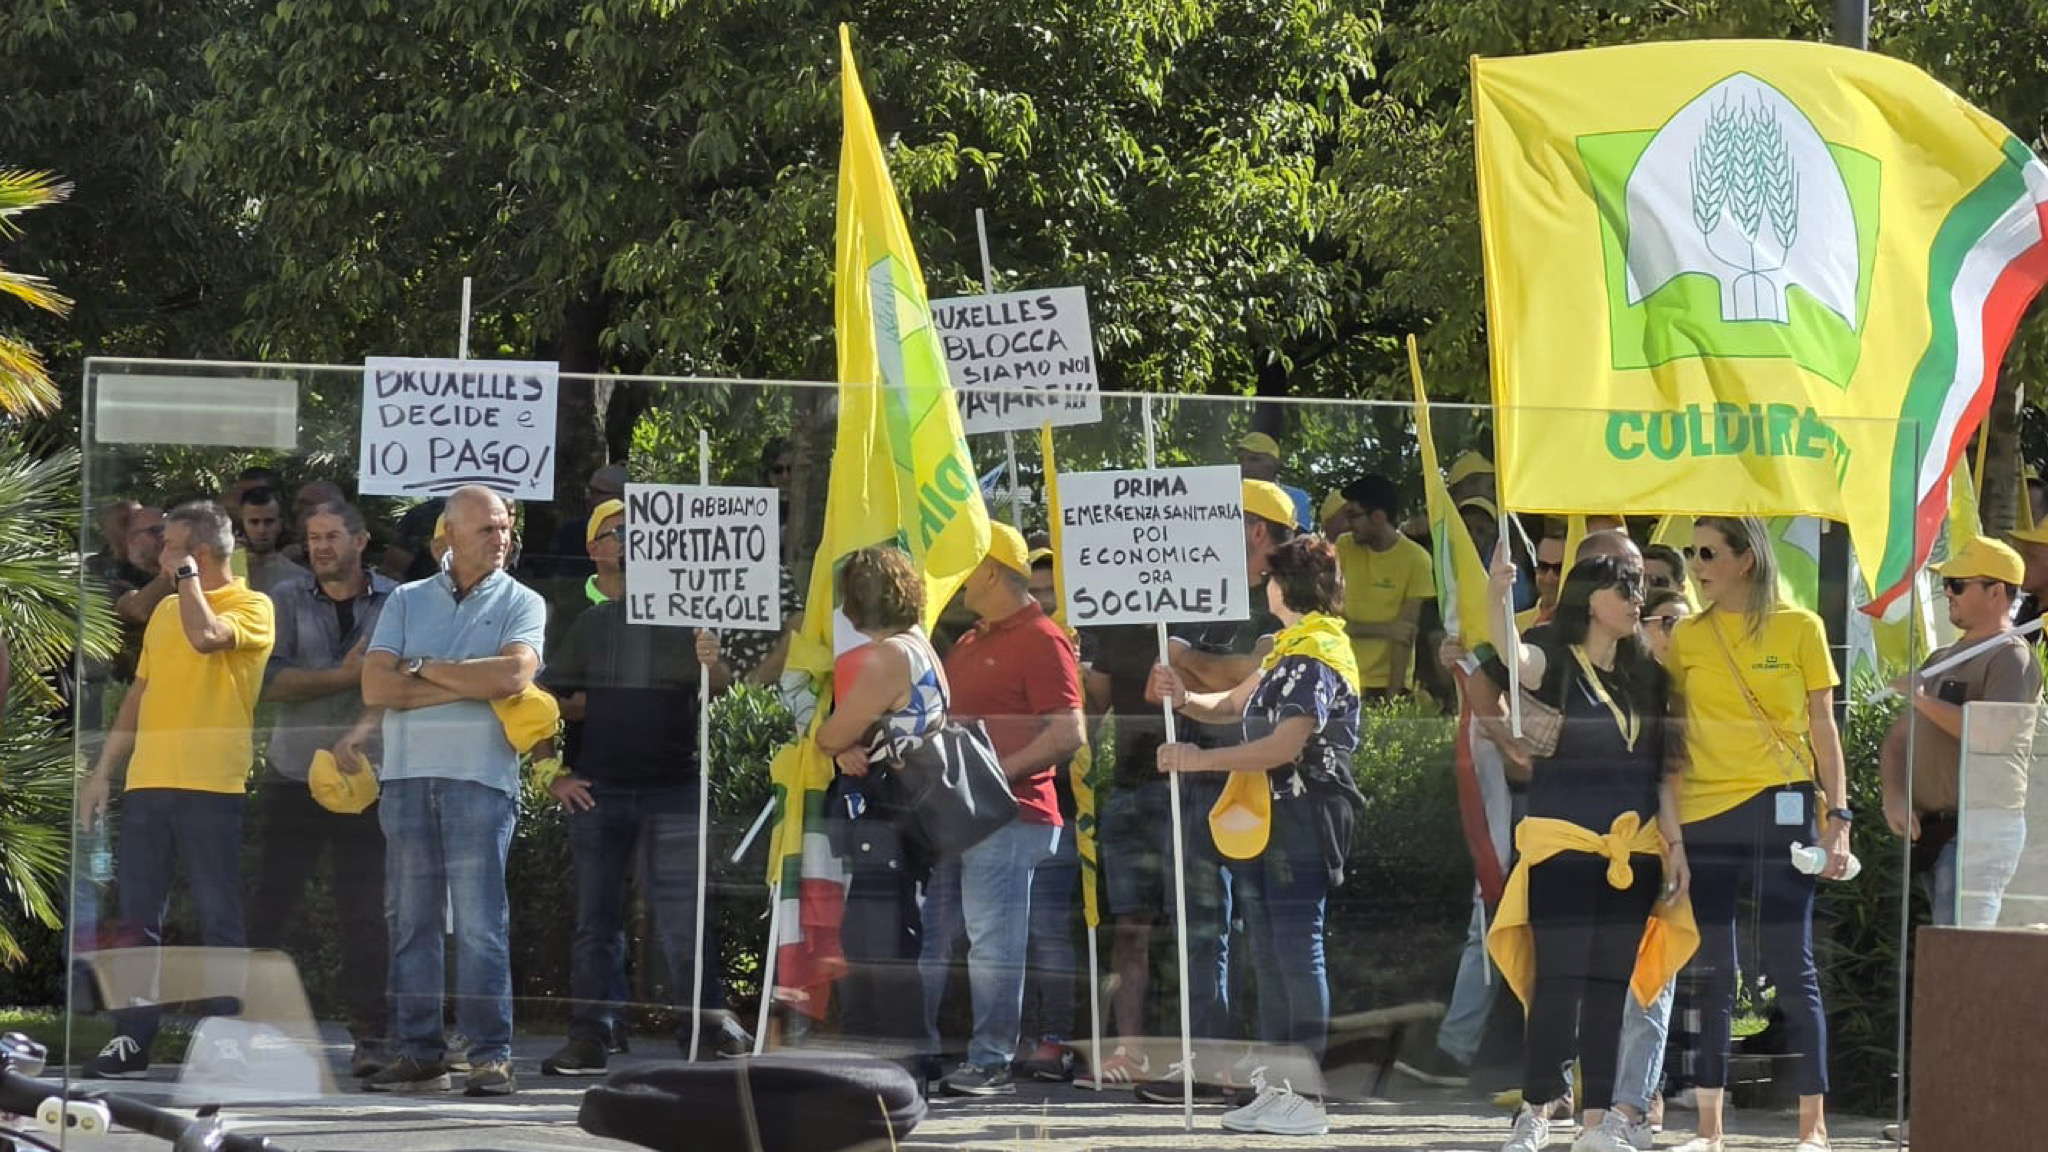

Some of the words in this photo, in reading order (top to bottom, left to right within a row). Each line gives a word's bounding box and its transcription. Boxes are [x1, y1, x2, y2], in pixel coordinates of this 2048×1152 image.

[942, 328, 1067, 361] BLOCCA
[963, 359, 1050, 385] SIAMO
[1059, 355, 1090, 376] NOI
[379, 403, 501, 428] DECIDE
[370, 441, 408, 476] IO
[428, 437, 550, 489] PAGO!
[1114, 475, 1188, 499] PRIMA
[629, 491, 684, 526] NOI
[691, 496, 768, 518] ABBIAMO
[1164, 503, 1241, 521] SANITARIA
[629, 524, 765, 562] RISPETTATO
[1133, 525, 1167, 544] POI
[1080, 545, 1220, 566] ECONOMICA
[668, 567, 749, 593] TUTTE
[1139, 569, 1173, 585] ORA
[631, 593, 655, 620] LE
[668, 593, 770, 623] REGOLE
[1073, 578, 1228, 619] SOCIALE!
